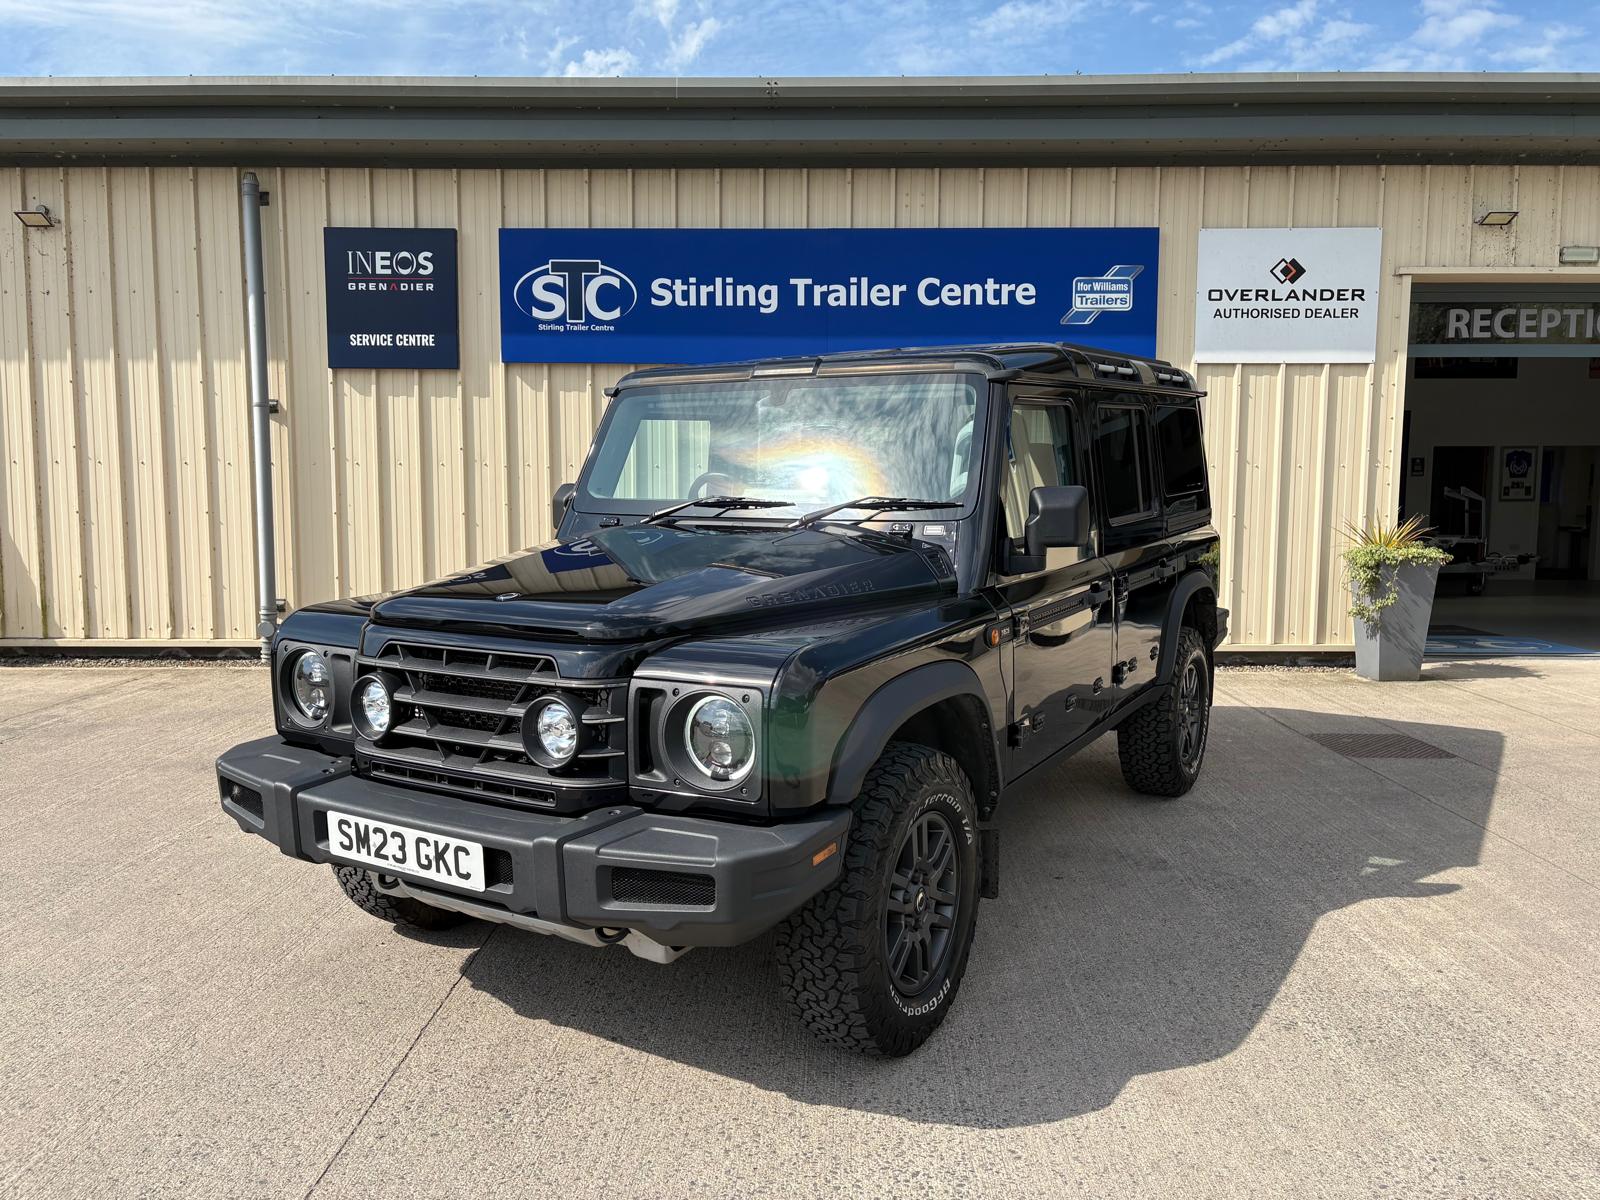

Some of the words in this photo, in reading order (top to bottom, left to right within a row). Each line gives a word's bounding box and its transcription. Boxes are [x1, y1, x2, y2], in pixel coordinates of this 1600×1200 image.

[347, 250, 434, 276] INEOS
[347, 282, 434, 292] GRENADIER
[531, 259, 621, 322] STC
[1077, 282, 1092, 292] Ifor
[1092, 282, 1129, 292] Williams
[651, 276, 778, 314] Stirling
[790, 277, 907, 307] Trailer
[917, 277, 1036, 307] Centre
[1077, 295, 1128, 306] Trailers
[1207, 288, 1366, 302] OVERLANDER
[1213, 308, 1301, 319] AUTHORISED
[1304, 307, 1360, 319] DEALER
[538, 323, 565, 332] Stirling
[566, 323, 590, 331] Trailer
[590, 323, 615, 331] Centre
[1447, 308, 1600, 339] RECEPTI
[350, 333, 394, 347] SERVICE
[396, 333, 436, 347] CENTRE
[745, 577, 875, 608] GRENADIER
[337, 818, 408, 865] SM23
[414, 836, 473, 881] GKC
